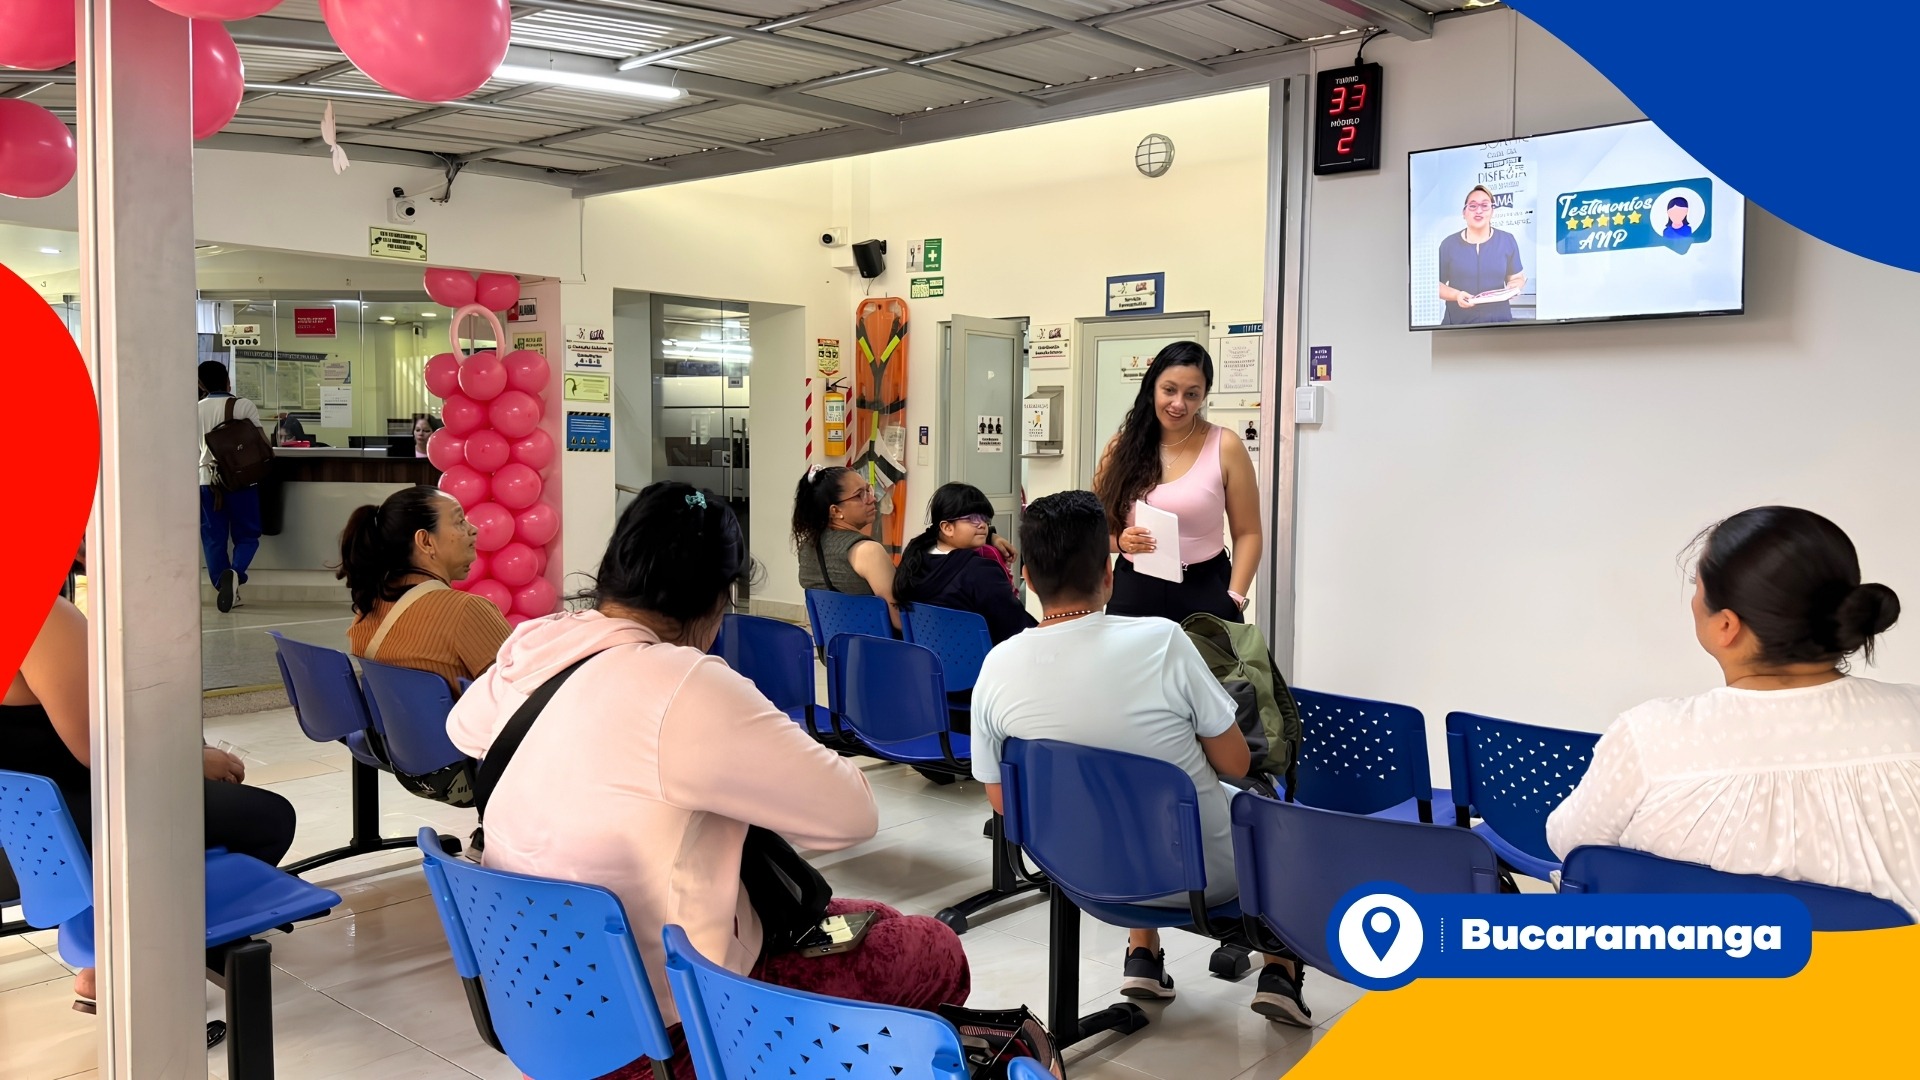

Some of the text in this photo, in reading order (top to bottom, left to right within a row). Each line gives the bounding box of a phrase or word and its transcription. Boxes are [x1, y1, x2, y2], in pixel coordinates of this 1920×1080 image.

[1329, 84, 1366, 114] 33
[1337, 126, 1356, 154] 2
[1559, 194, 1653, 219] Testimonios
[1579, 229, 1628, 249] ANP
